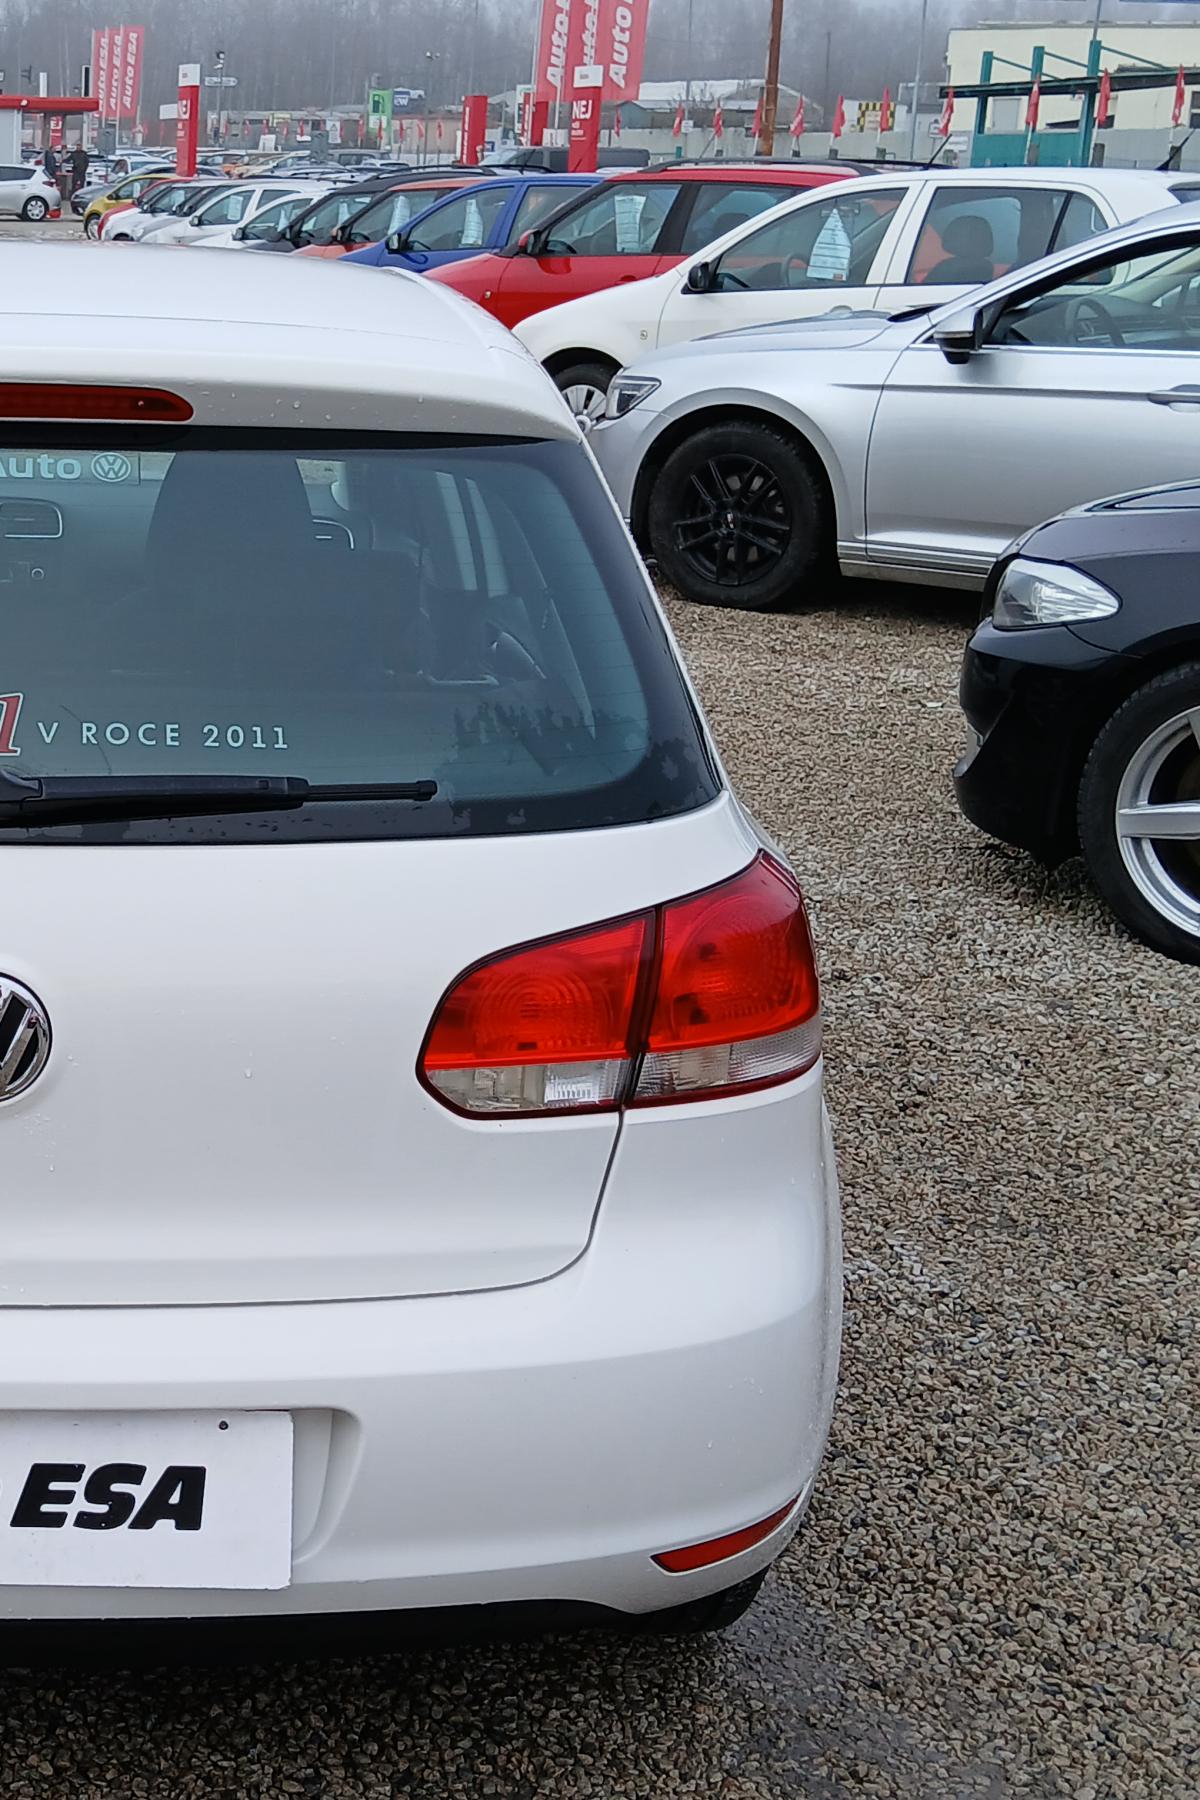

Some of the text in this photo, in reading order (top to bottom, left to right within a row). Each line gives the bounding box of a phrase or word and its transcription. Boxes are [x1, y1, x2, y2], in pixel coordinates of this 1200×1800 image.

[609, 6, 633, 89] Auto
[109, 67, 120, 110] Auto
[122, 65, 135, 109] Auto
[572, 99, 593, 119] NEJ
[37, 721, 59, 744] V
[81, 722, 180, 746] ROCE
[202, 724, 289, 749] 2011
[9, 1462, 207, 1531] ESA
